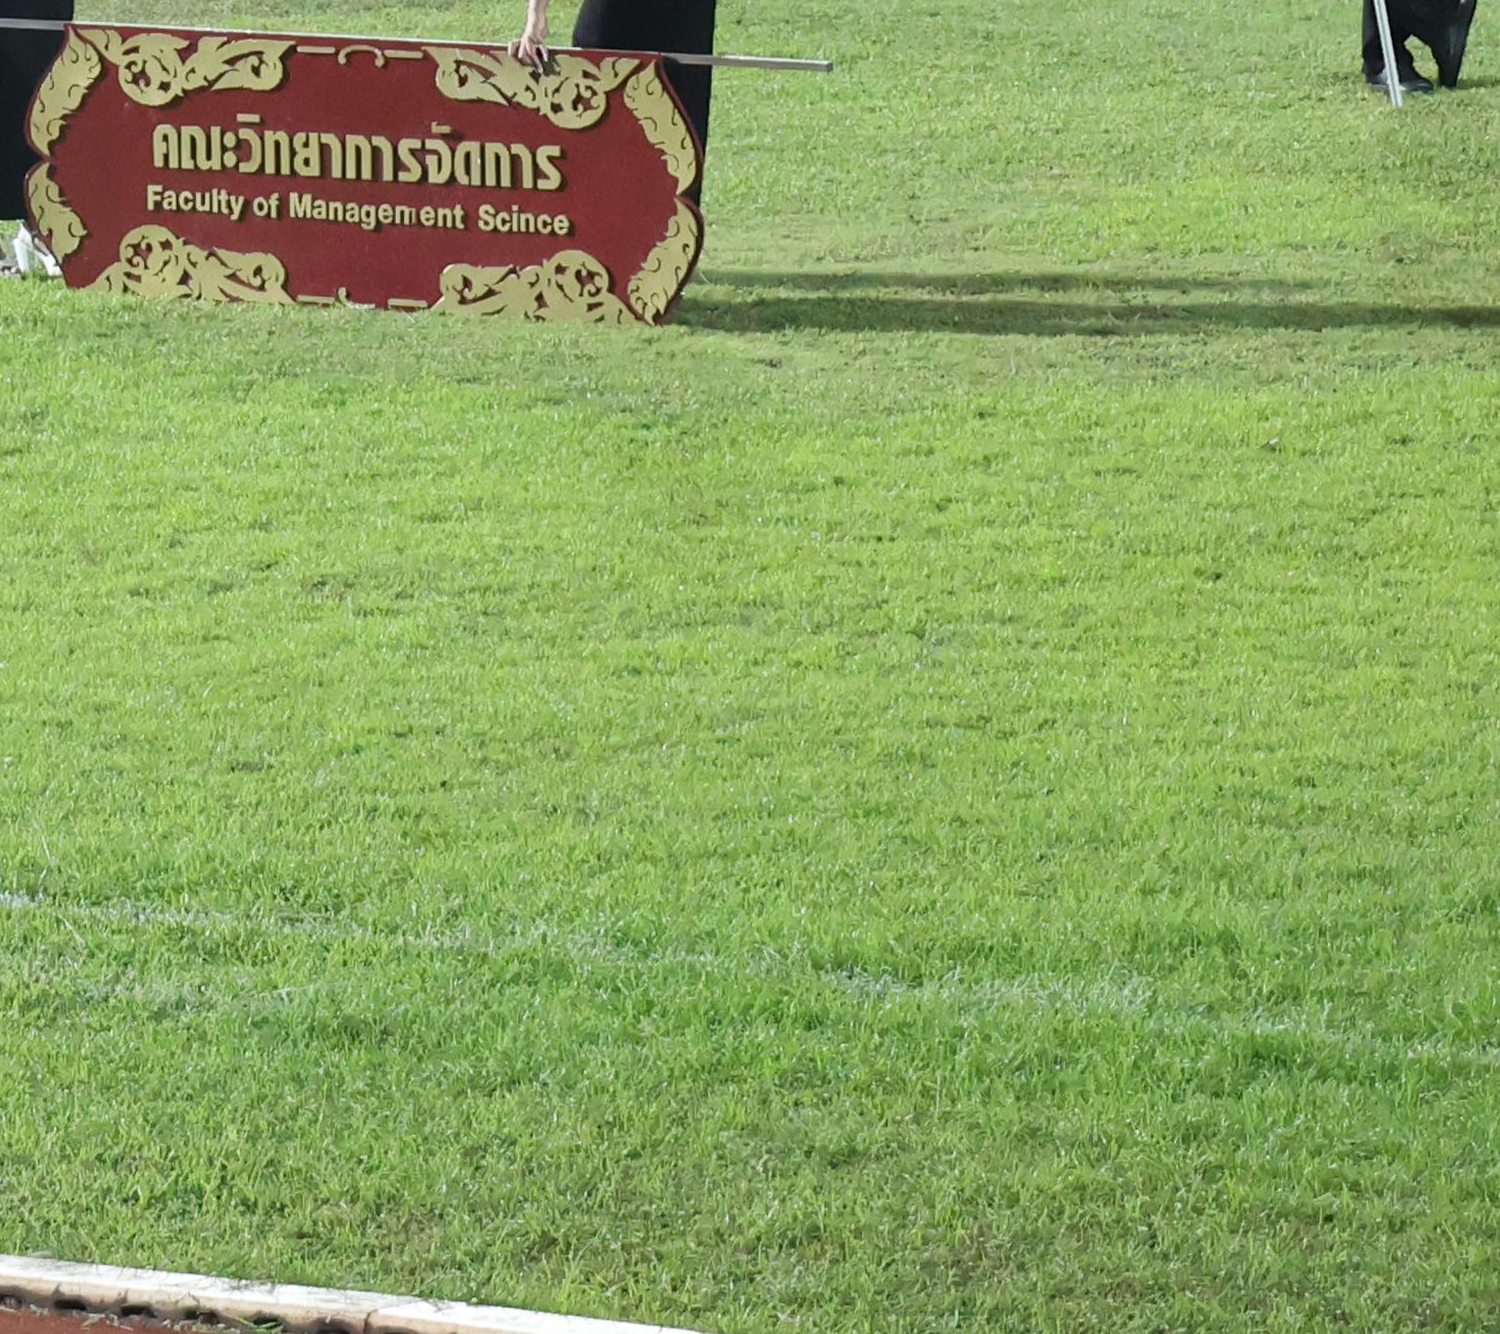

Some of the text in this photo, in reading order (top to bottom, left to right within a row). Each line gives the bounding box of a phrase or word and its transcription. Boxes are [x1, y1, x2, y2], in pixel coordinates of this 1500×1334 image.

[153, 113, 561, 190] คณะวิทยาการจัดการ
[147, 184, 570, 236] Faculty of Management Scince
